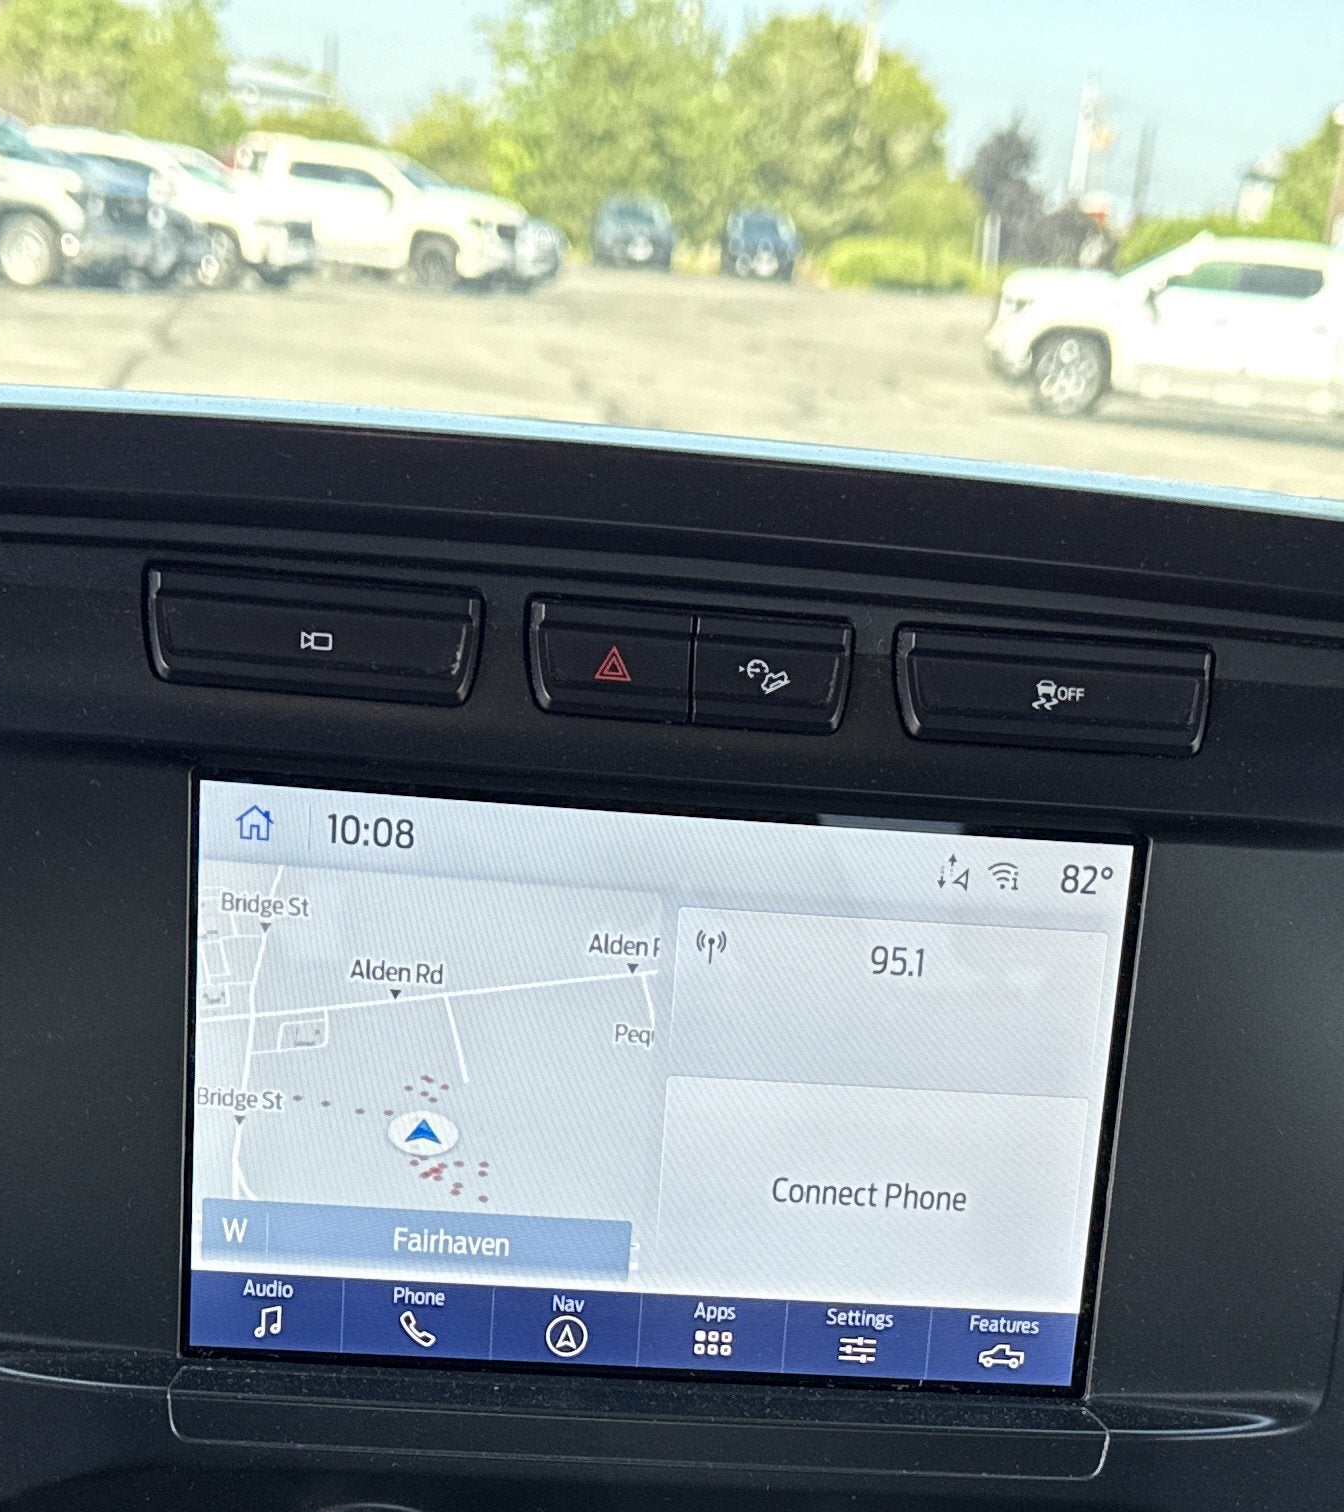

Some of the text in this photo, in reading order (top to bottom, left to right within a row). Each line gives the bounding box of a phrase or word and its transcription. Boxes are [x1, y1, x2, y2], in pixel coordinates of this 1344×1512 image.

[1057, 686, 1085, 702] OFF
[327, 812, 416, 850] 10:08
[1060, 864, 1114, 895] 82°
[222, 892, 309, 918] Bridge St
[589, 932, 649, 956] Alden
[350, 959, 444, 985] Alden Rd
[871, 945, 925, 978] 95.1
[197, 1087, 284, 1112] Bridge St
[772, 1176, 968, 1212] Connect Phone
[222, 1218, 248, 1243] W
[393, 1227, 510, 1257] Fairhaven
[242, 1279, 294, 1300] Audio
[393, 1286, 446, 1307] Phone
[552, 1296, 585, 1313] Nav
[693, 1303, 737, 1325] Apps
[826, 1307, 895, 1329] Settings
[968, 1315, 1040, 1335] Features
